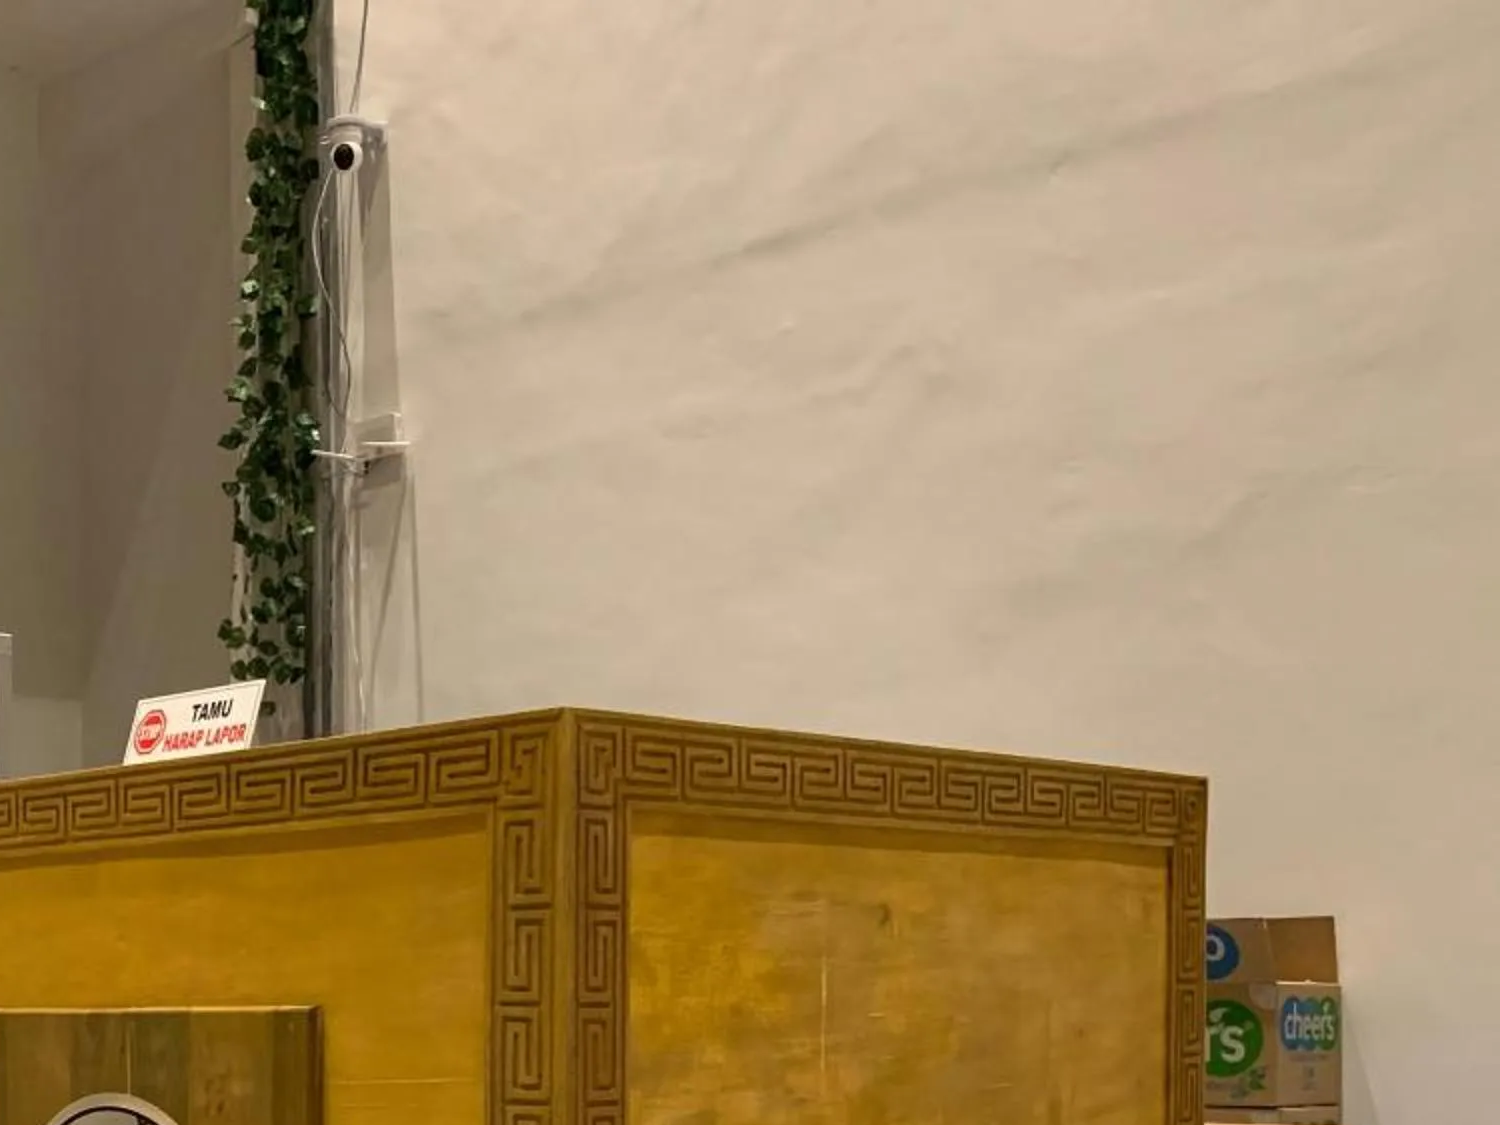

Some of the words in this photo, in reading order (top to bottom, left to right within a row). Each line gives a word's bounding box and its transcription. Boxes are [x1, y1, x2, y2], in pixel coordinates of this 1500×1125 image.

[192, 699, 233, 722] TAMU
[162, 729, 204, 752] HARAP
[204, 723, 247, 746] LAPOR
